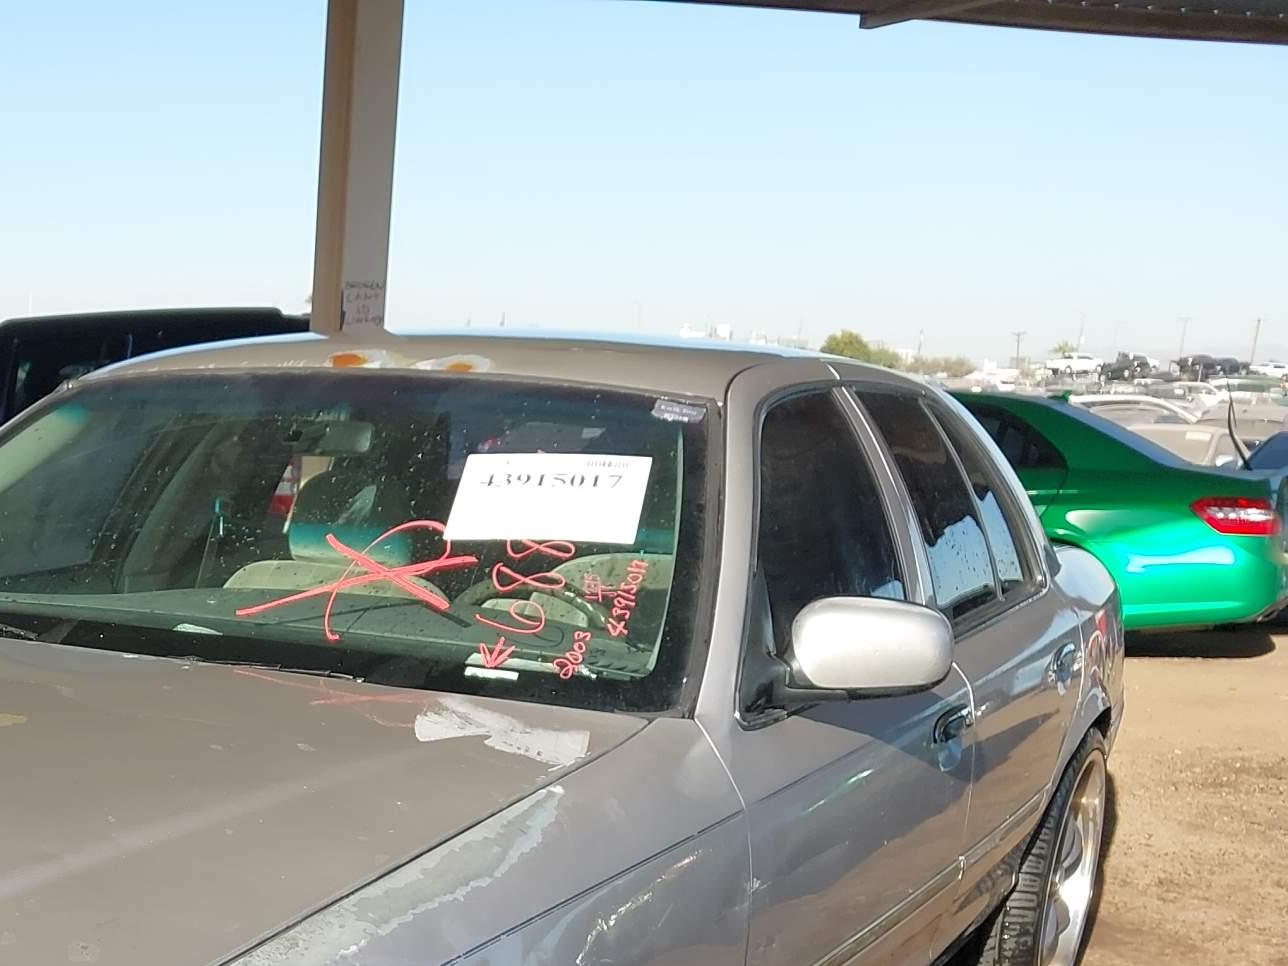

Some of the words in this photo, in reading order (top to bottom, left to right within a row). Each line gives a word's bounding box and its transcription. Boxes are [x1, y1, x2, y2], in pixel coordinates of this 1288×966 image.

[480, 472, 625, 489] 43915017
[607, 559, 649, 637] 43915017
[552, 630, 592, 679] 2003
